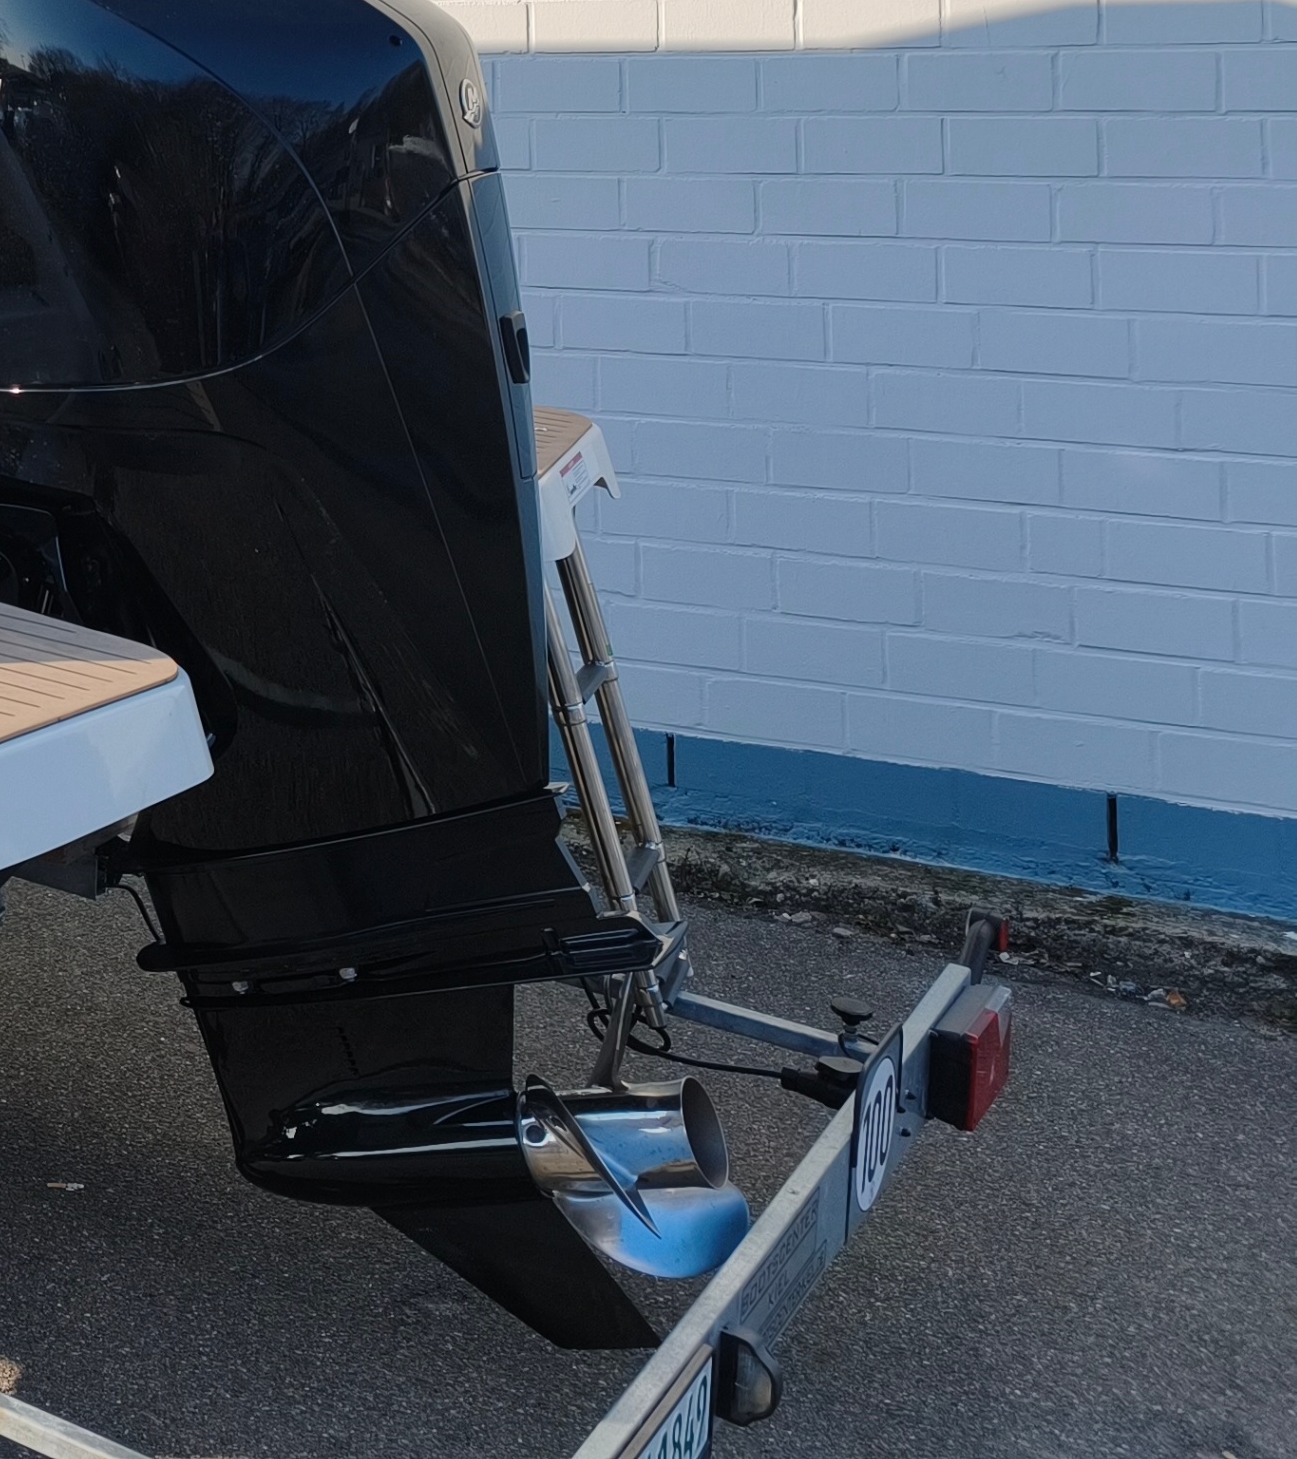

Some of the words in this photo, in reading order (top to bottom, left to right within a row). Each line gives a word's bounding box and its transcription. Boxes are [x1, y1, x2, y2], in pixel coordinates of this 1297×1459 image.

[861, 1074, 893, 1194] 100
[741, 1197, 818, 1316] BOOTSCENTER
[768, 1269, 790, 1310] KIEL
